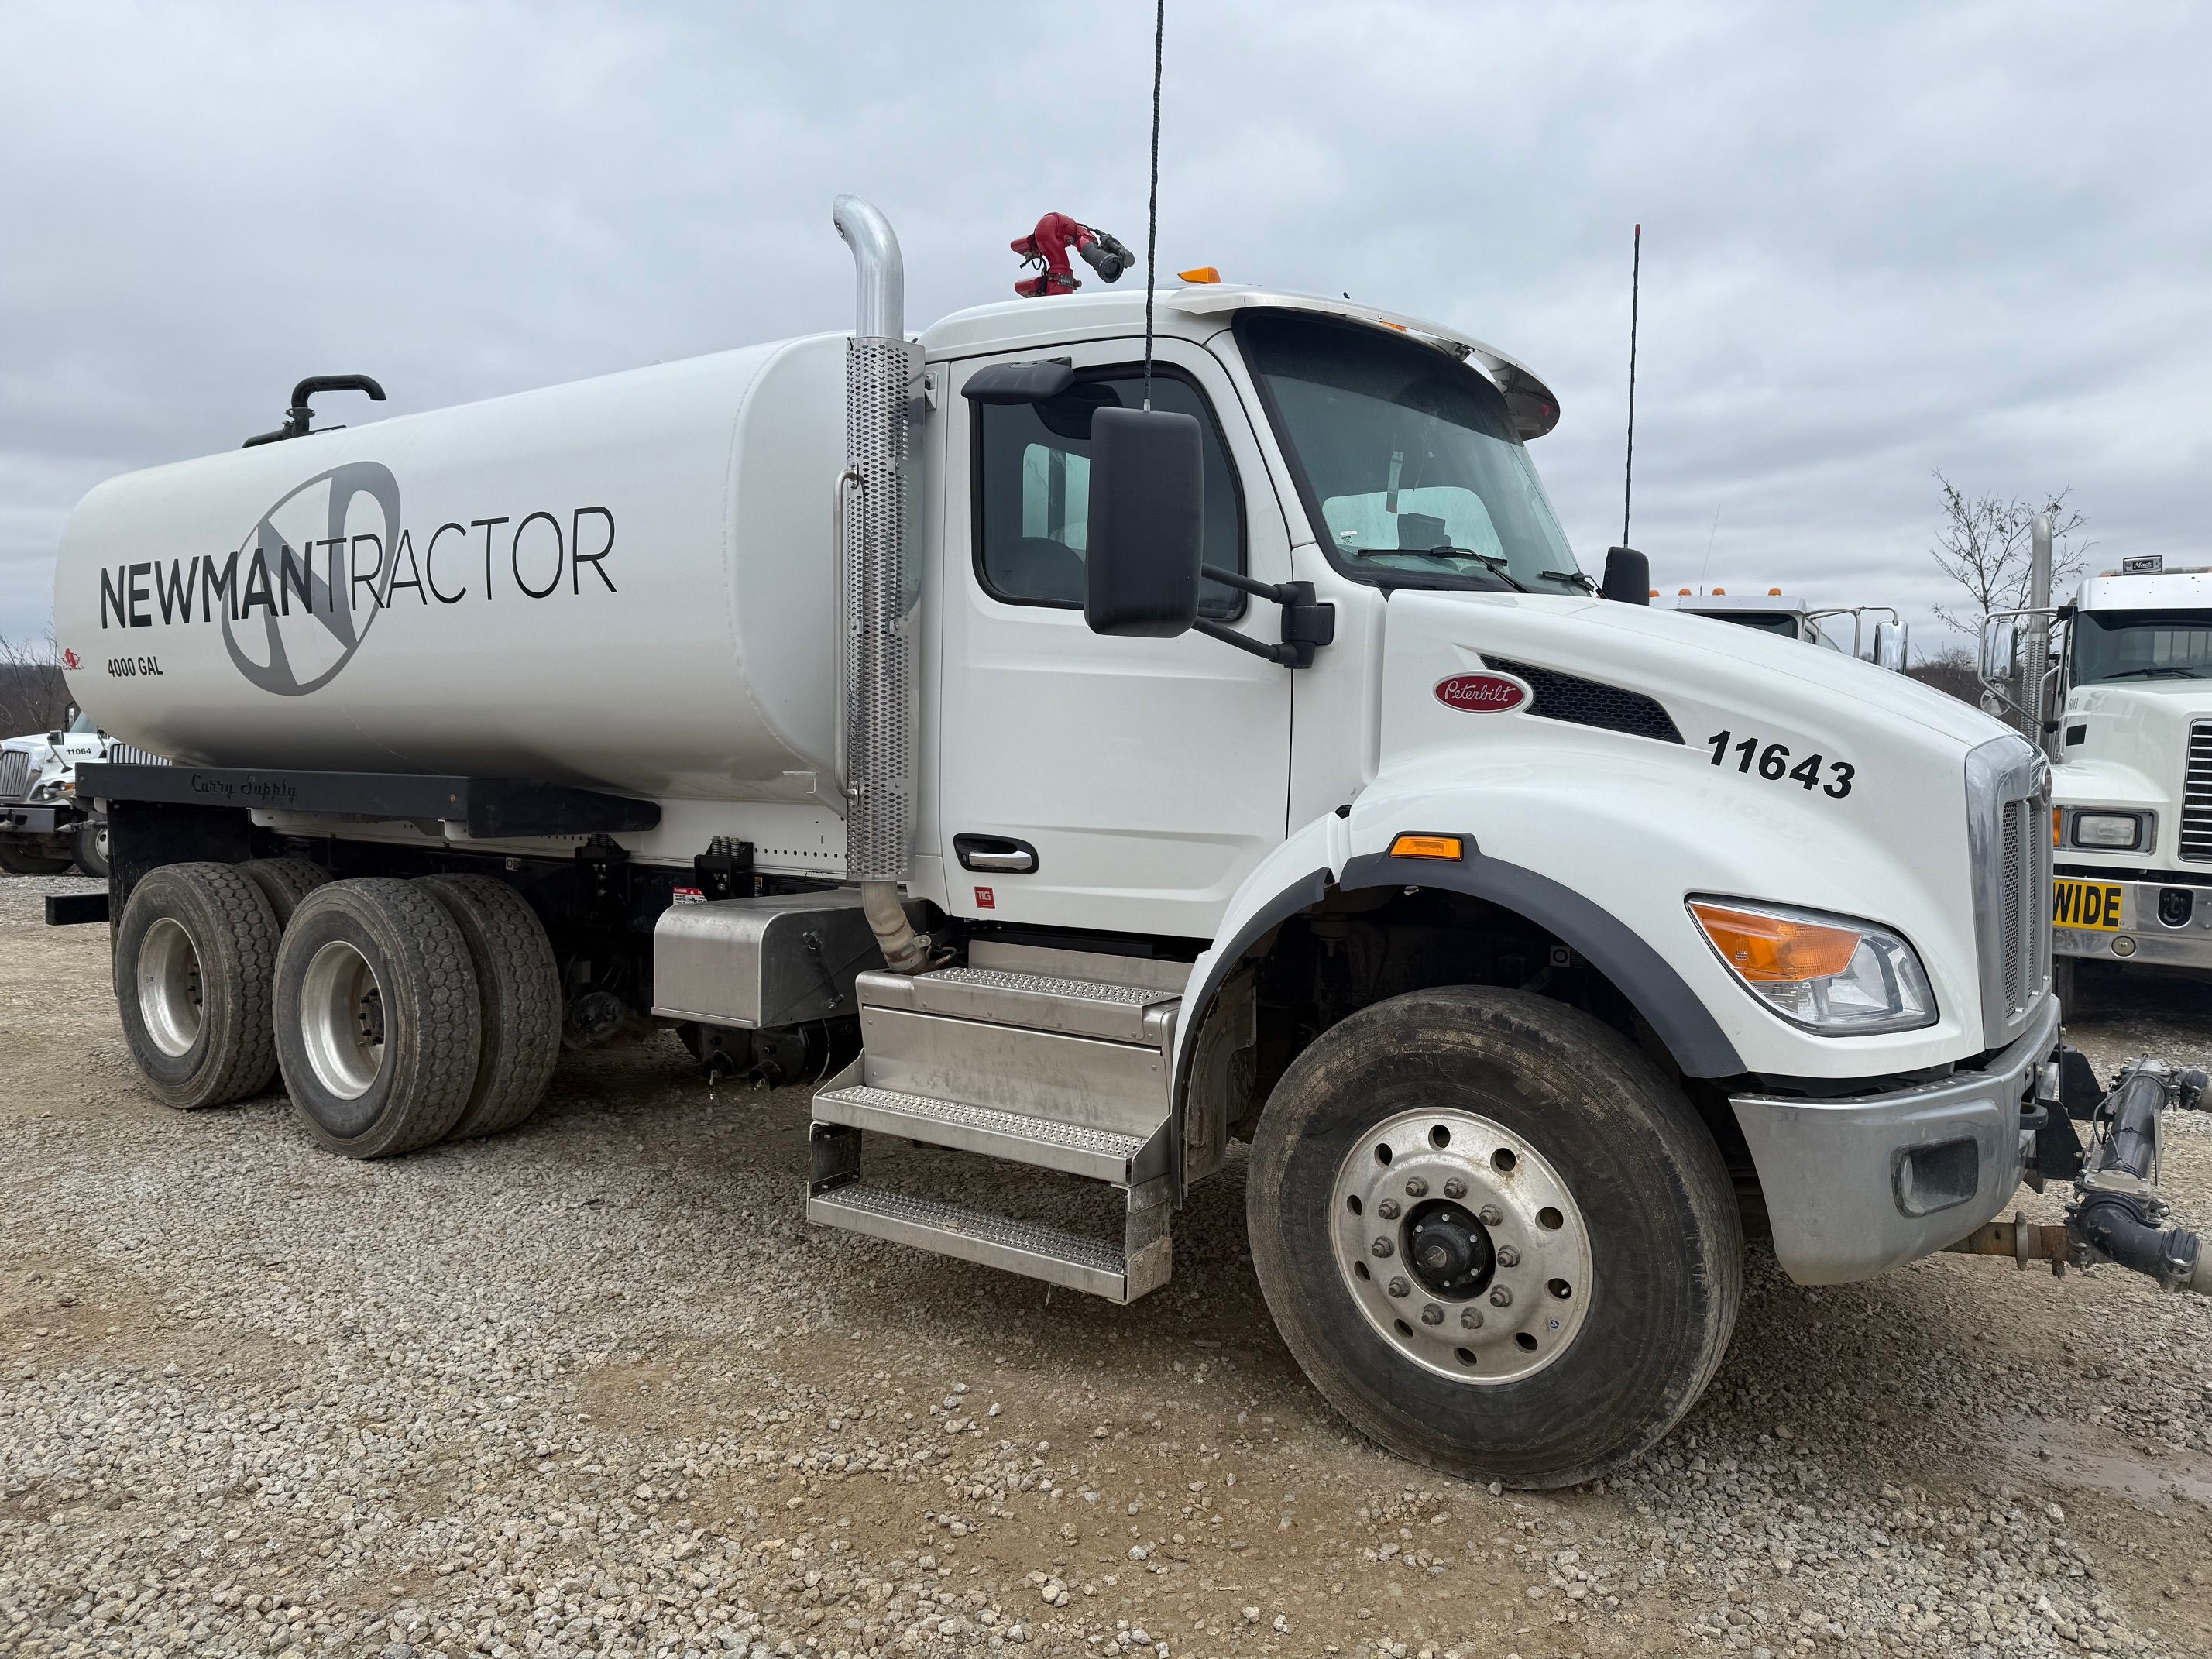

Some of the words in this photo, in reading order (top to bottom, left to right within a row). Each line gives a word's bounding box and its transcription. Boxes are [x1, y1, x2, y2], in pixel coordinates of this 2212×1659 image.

[108, 657, 136, 678] 4000
[137, 655, 163, 676] GAL
[1444, 680, 1516, 702] Peterbilt
[66, 747, 91, 756] 11064
[1707, 730, 1855, 799] 11643
[191, 774, 235, 800] Curry
[240, 775, 297, 805] Supply
[976, 890, 992, 901] TIG
[2053, 881, 2121, 927] WIDE
